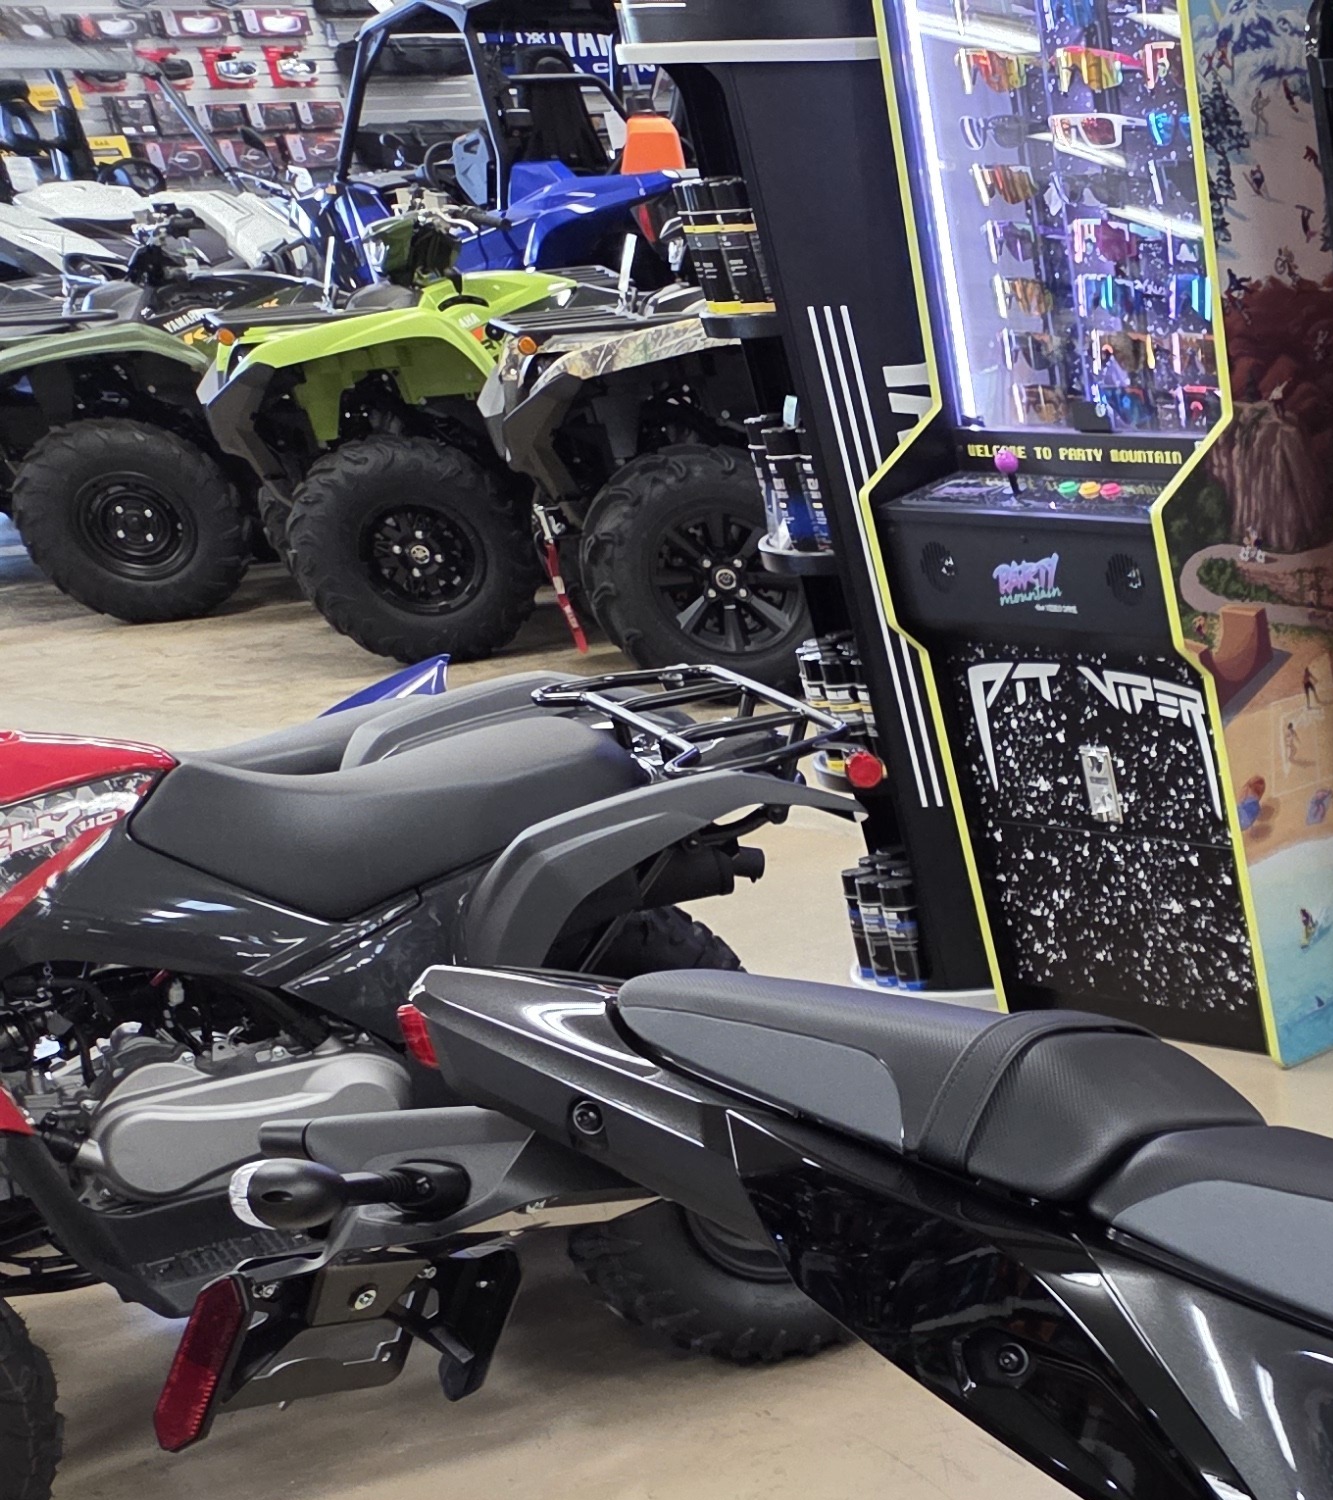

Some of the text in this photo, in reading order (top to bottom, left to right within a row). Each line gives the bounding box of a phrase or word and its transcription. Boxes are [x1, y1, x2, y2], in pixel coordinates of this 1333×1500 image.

[968, 444, 1182, 465] WELCE TO PARTY MOUNTAIN
[968, 662, 1223, 821] PIT VIPER
[79, 810, 118, 832] 110
